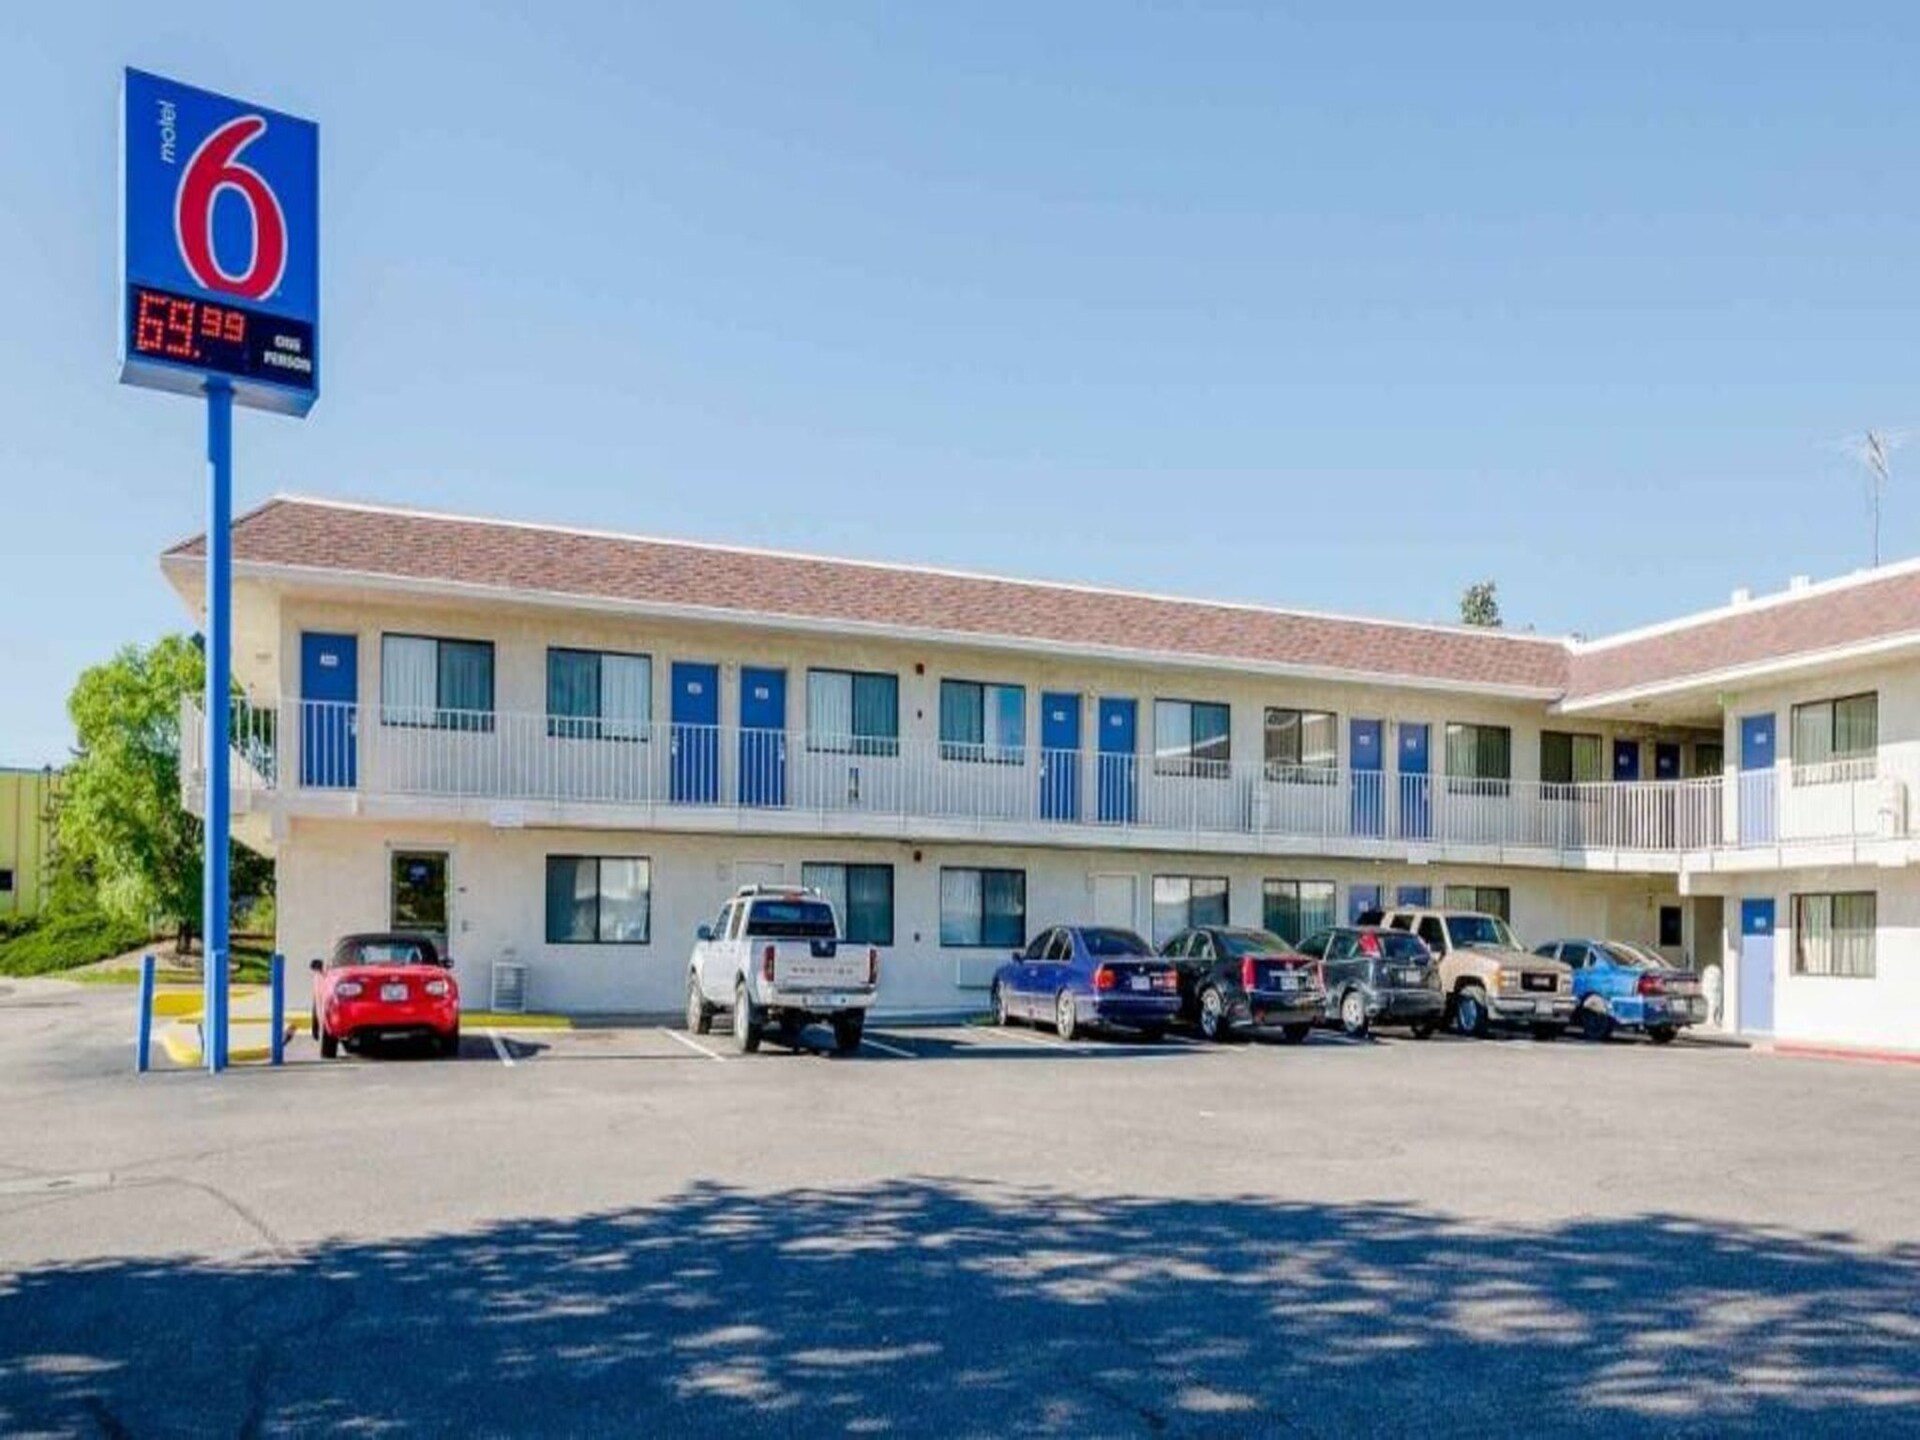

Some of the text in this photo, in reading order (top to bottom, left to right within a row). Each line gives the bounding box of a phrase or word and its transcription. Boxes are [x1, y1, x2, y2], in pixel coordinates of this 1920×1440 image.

[155, 99, 177, 164] motel
[173, 114, 288, 301] 6
[263, 350, 311, 373] PERSON
